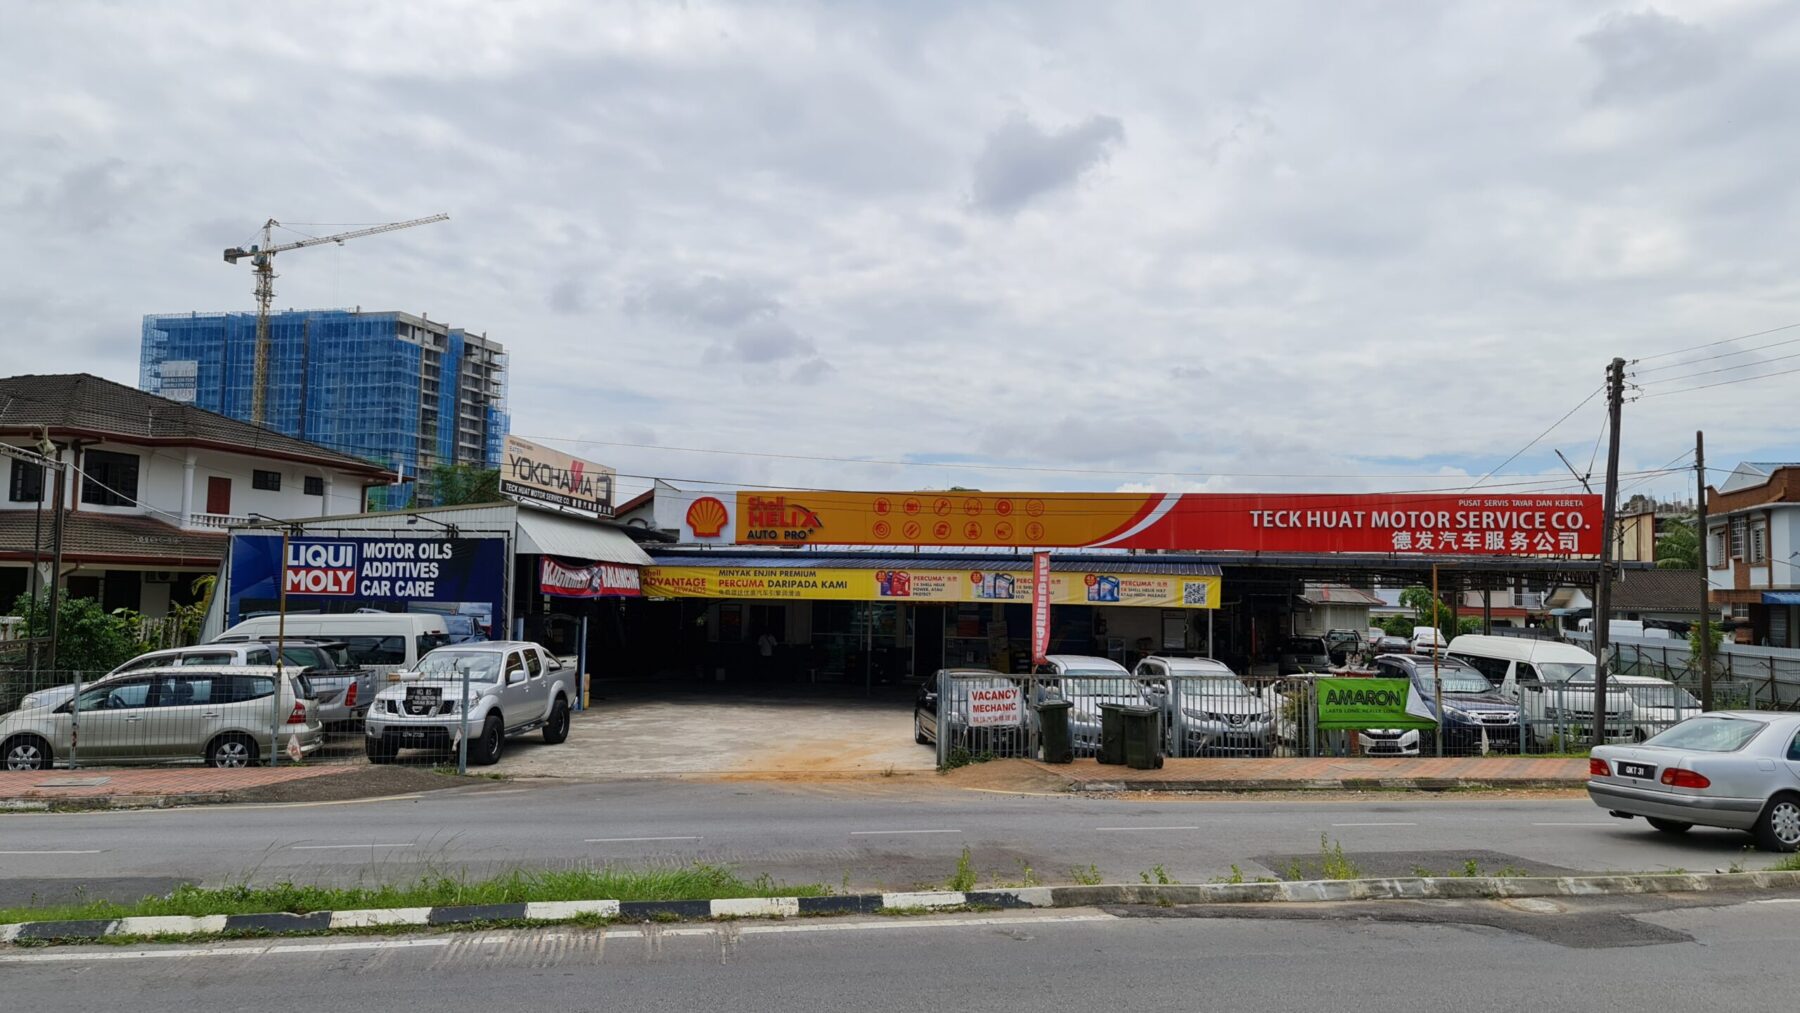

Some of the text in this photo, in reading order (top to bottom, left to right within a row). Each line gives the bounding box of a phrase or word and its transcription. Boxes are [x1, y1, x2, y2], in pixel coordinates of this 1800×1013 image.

[509, 453, 593, 497] YOKOHAMA
[506, 483, 518, 492] TECK
[518, 485, 530, 495] HUAT
[530, 488, 546, 499] MOTOR
[546, 491, 563, 503] SERVICE
[748, 496, 784, 511] Shell
[1458, 499, 1584, 507] PUSAT SERVIS TAYAR DAN KERETA
[748, 511, 821, 528] HELIX
[1250, 510, 1591, 530] TECK HUAT MOTOR SERVICE CO.
[747, 530, 777, 540] AUTO
[1392, 530, 1578, 552] 德发汽车服务公司
[287, 545, 353, 568] LIQUI
[363, 543, 453, 560] MOTOR OILS
[361, 562, 439, 579] ADDITIVES
[643, 569, 661, 577] Shell
[286, 570, 354, 592] MOLY
[360, 580, 435, 597] CAR CARE
[642, 578, 706, 587] ADVANTAGE
[719, 580, 848, 589] PERCUMA DARIPADA KAMI
[971, 689, 1018, 701] VACANCY
[1326, 689, 1400, 706] AMARON
[973, 703, 1017, 713] MECHANIC
